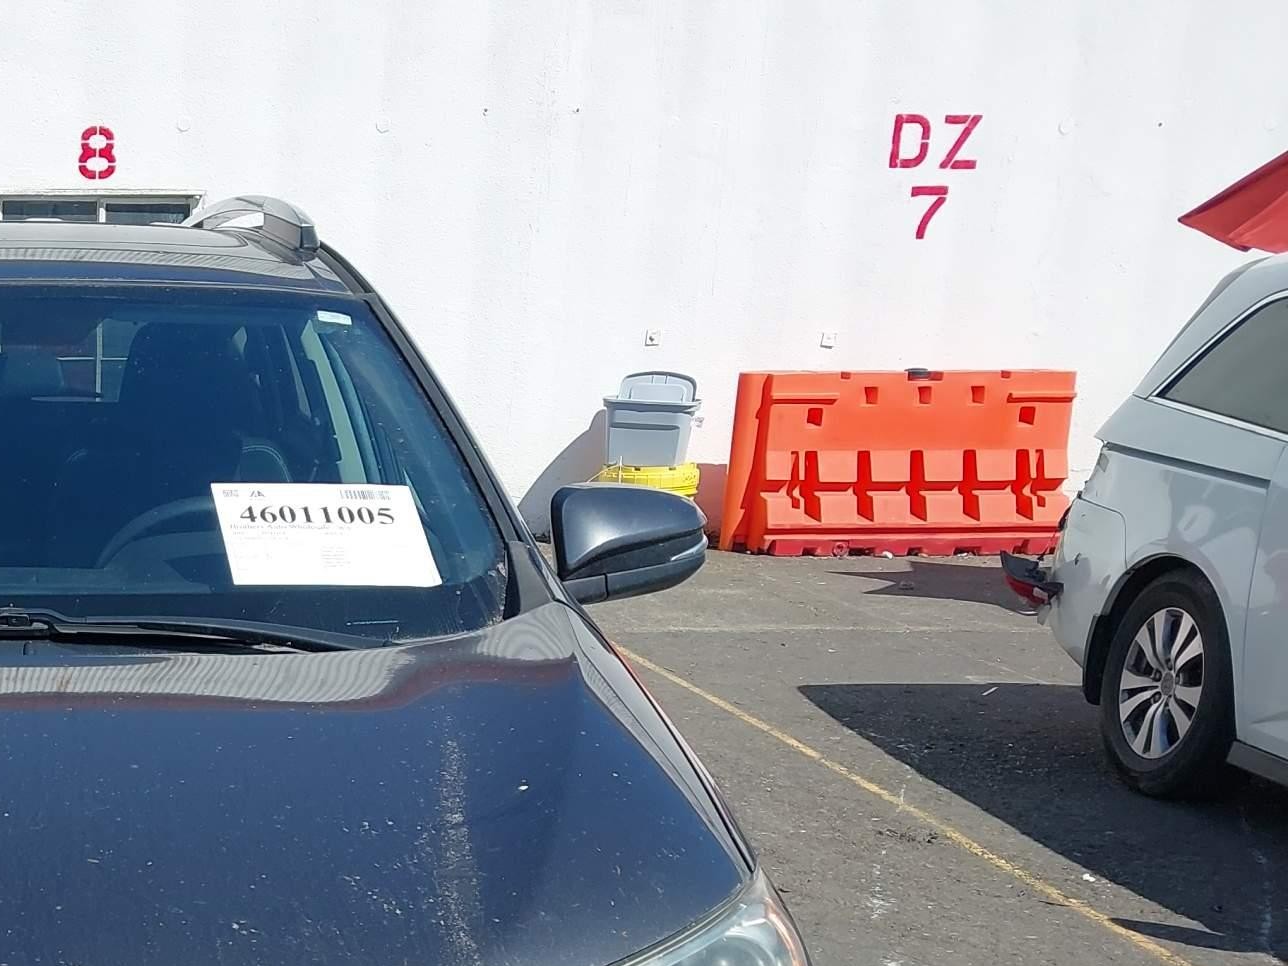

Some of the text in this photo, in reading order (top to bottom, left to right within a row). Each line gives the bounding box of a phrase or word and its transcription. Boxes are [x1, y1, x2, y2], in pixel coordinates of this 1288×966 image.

[79, 126, 116, 181] 8
[889, 114, 983, 170] DZ
[911, 186, 948, 240] 7
[239, 505, 395, 525] 46011005
